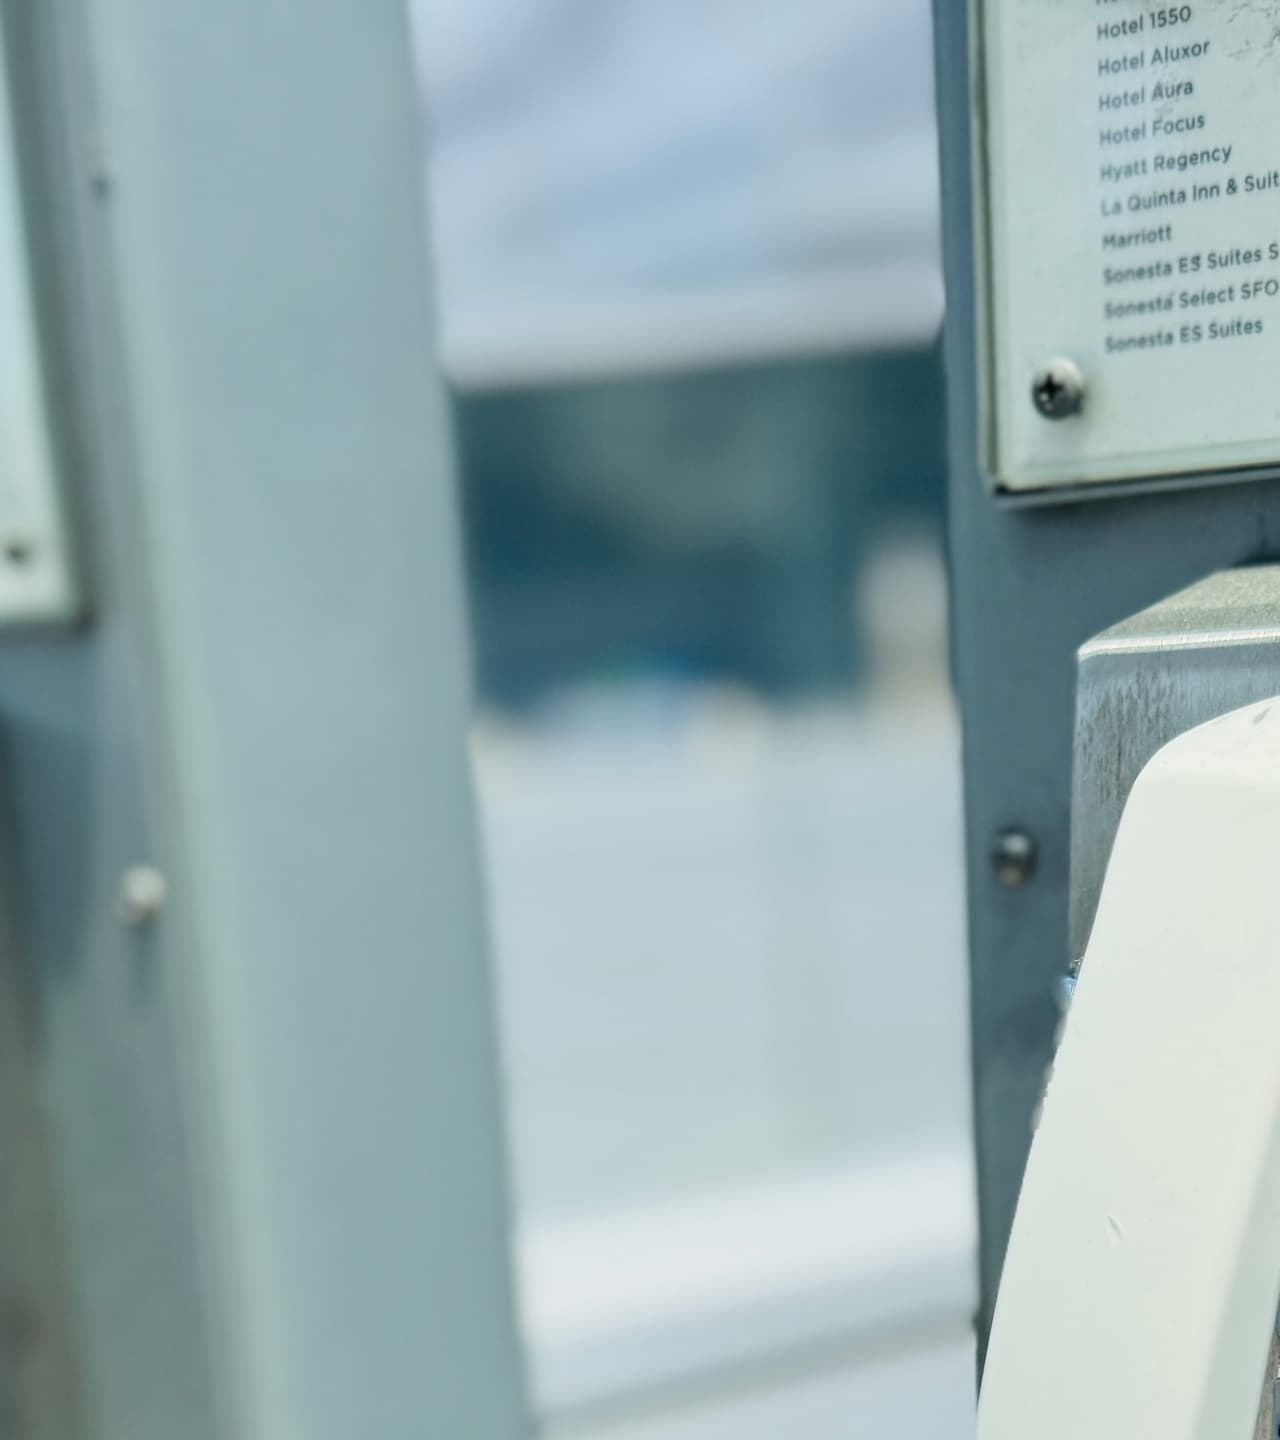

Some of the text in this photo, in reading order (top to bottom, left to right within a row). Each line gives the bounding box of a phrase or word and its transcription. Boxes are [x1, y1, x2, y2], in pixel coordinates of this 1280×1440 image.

[1096, 5, 1192, 41] Hotel 1550
[1097, 51, 1144, 77] Hotel
[1151, 40, 1210, 65] Aluxor
[1098, 86, 1145, 112] Hotel
[1151, 80, 1194, 102] Aura
[1099, 121, 1146, 147] Hotel
[1152, 114, 1205, 137] Focus
[1100, 158, 1147, 185] Hyatt
[1153, 145, 1232, 172] Regency
[1101, 199, 1121, 217] La
[1127, 189, 1187, 213] Quinta
[1193, 184, 1220, 202] Inn
[1226, 178, 1238, 195] &
[1103, 224, 1173, 250] Marriott
[1103, 261, 1173, 286] Sonesta
[1178, 254, 1201, 274] ES
[1207, 247, 1262, 270] Suites
[1104, 294, 1173, 320] Sonesta
[1179, 285, 1235, 309] Select
[1241, 279, 1279, 300] SFO
[1105, 330, 1174, 354] Sonesta
[1179, 325, 1202, 344] ES
[1208, 317, 1263, 340] Suites
